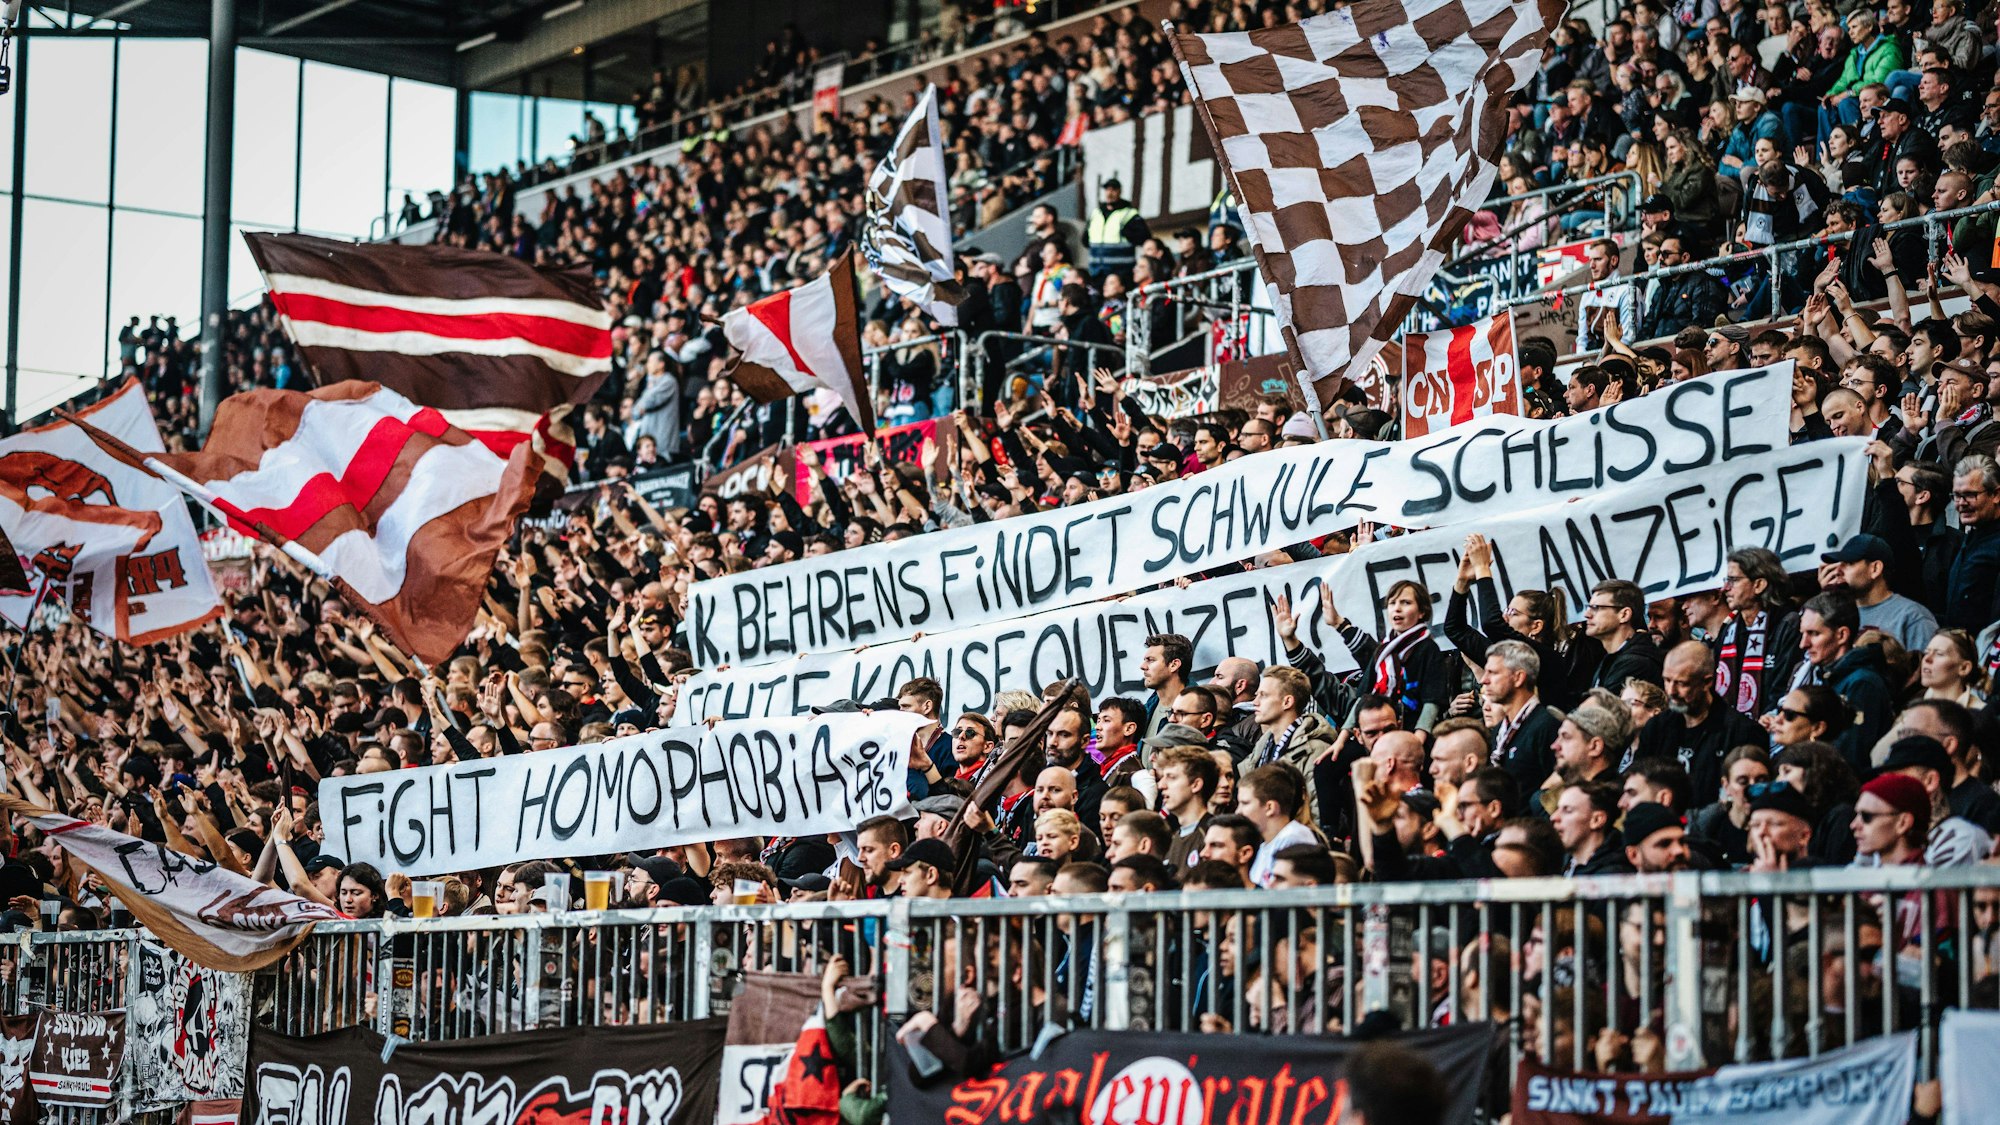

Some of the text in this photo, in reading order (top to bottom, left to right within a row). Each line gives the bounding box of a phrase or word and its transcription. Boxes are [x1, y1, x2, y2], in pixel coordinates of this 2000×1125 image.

[733, 560, 931, 663] BEHRENS
[940, 505, 1133, 620] FiNDET
[1143, 446, 1391, 573] SCHWULE
[1401, 369, 1771, 517] SCHEiSSE
[341, 767, 497, 867] FiGHT
[515, 724, 851, 853] HOMOPHOBiA
[1527, 1075, 1616, 1116] SANKT
